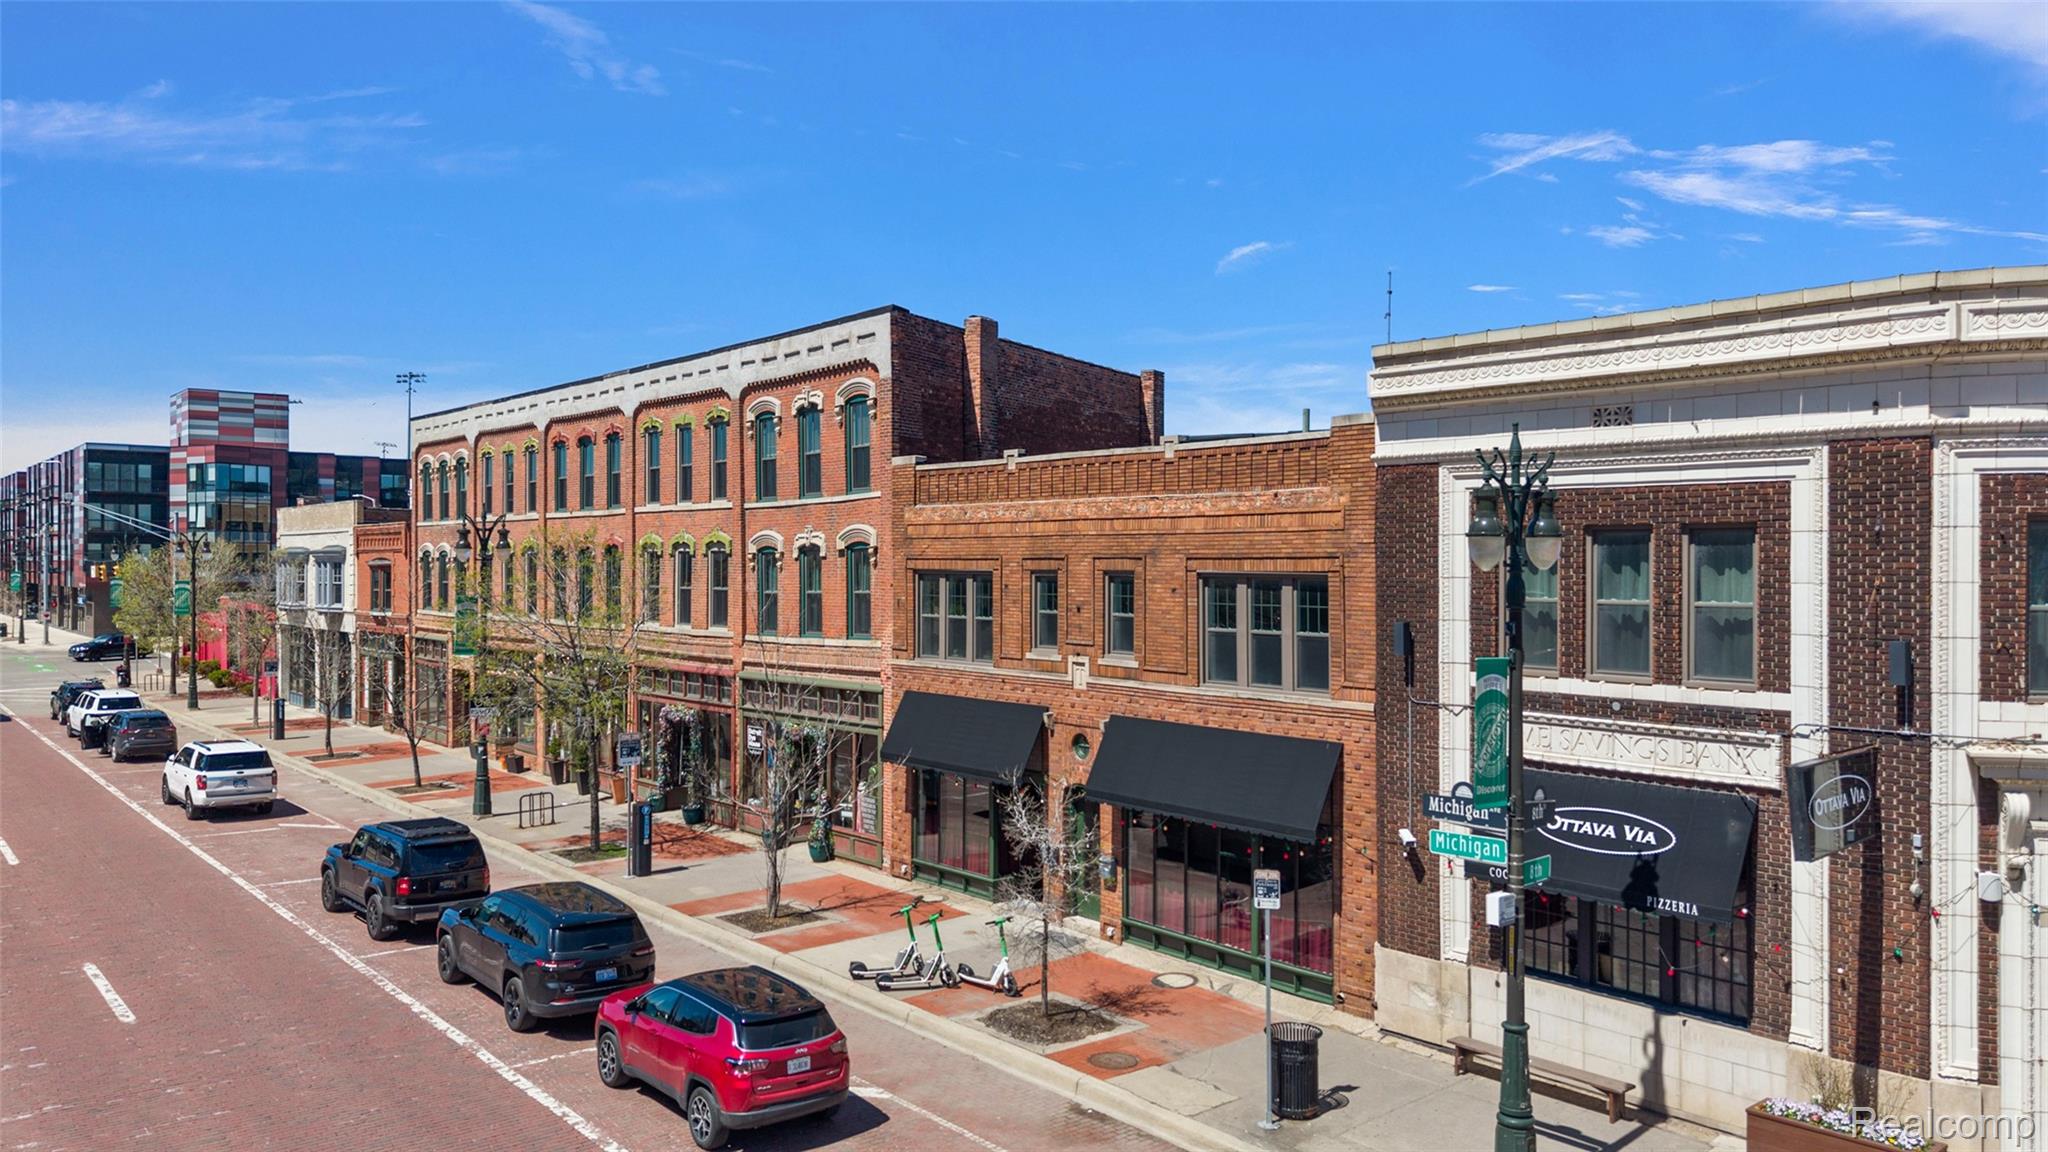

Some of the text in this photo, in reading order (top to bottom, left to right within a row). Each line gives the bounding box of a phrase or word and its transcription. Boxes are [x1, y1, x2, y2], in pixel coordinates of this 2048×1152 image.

[1559, 728, 1669, 761] SAVINGS
[1681, 740, 1764, 774] BANK
[1428, 796, 1490, 821] Michigan
[1814, 786, 1866, 817] OTTAVA VIA
[1435, 832, 1501, 859] Michigan
[1623, 824, 1657, 846] VIA
[1489, 866, 1509, 880] COC
[1646, 895, 1699, 917] PIZZERIA
